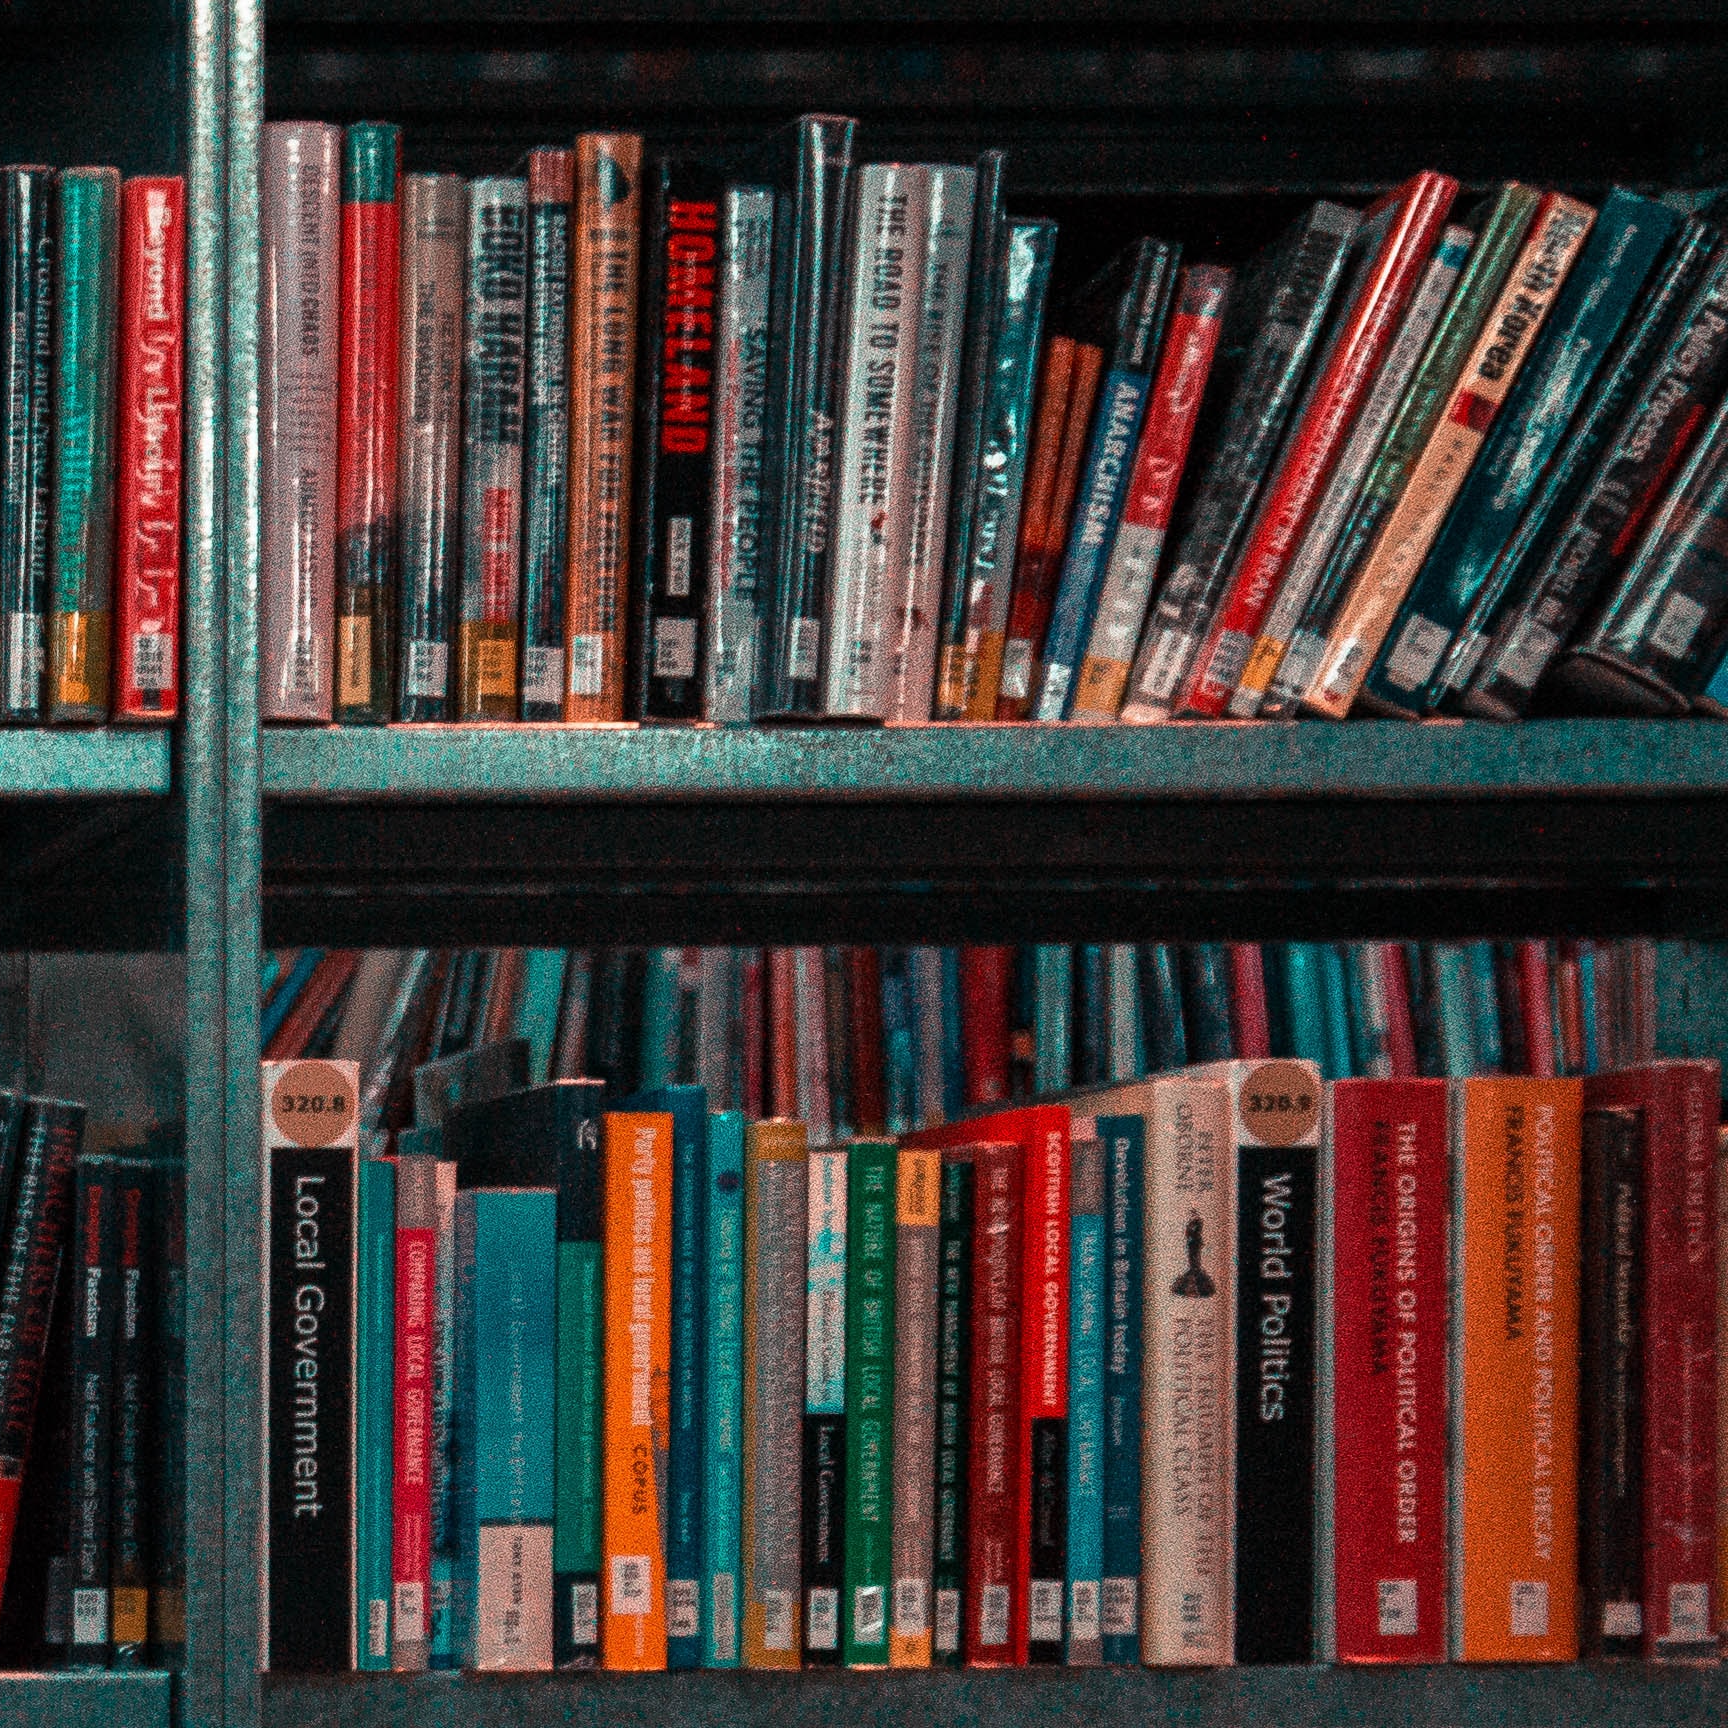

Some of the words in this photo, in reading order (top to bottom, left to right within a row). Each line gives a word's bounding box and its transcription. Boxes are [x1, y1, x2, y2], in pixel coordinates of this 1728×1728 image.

[877, 195, 908, 237] THE
[872, 248, 904, 312] ROAD
[661, 200, 718, 454] HOMELAND
[869, 323, 898, 350] TO
[860, 361, 896, 506] SOMEWHERE
[1082, 383, 1141, 547] ANARCHISM
[281, 1094, 346, 1114] 320.8
[1397, 1122, 1416, 1168] THE
[1044, 1132, 1062, 1214] SCOTTISH
[1533, 1105, 1551, 1216] POLITICAL
[296, 1176, 325, 1269] Local
[1044, 1221, 1061, 1276] LOCAL
[1261, 1174, 1289, 1278] World
[1396, 1174, 1417, 1280] ORIGINS
[1533, 1223, 1552, 1301] ORDER
[1042, 1282, 1059, 1406] GOVERNMENT
[1397, 1289, 1417, 1323] OF
[1534, 1308, 1552, 1359] AND
[294, 1284, 324, 1518] Government
[1259, 1294, 1290, 1420] Politics
[1397, 1332, 1417, 1452] POLITICAL
[818, 1426, 832, 1467] Local
[1534, 1367, 1552, 1479] POLITICAL
[816, 1470, 834, 1563] Government
[1397, 1460, 1416, 1544] ORDER
[1534, 1486, 1552, 1560] DECAY
